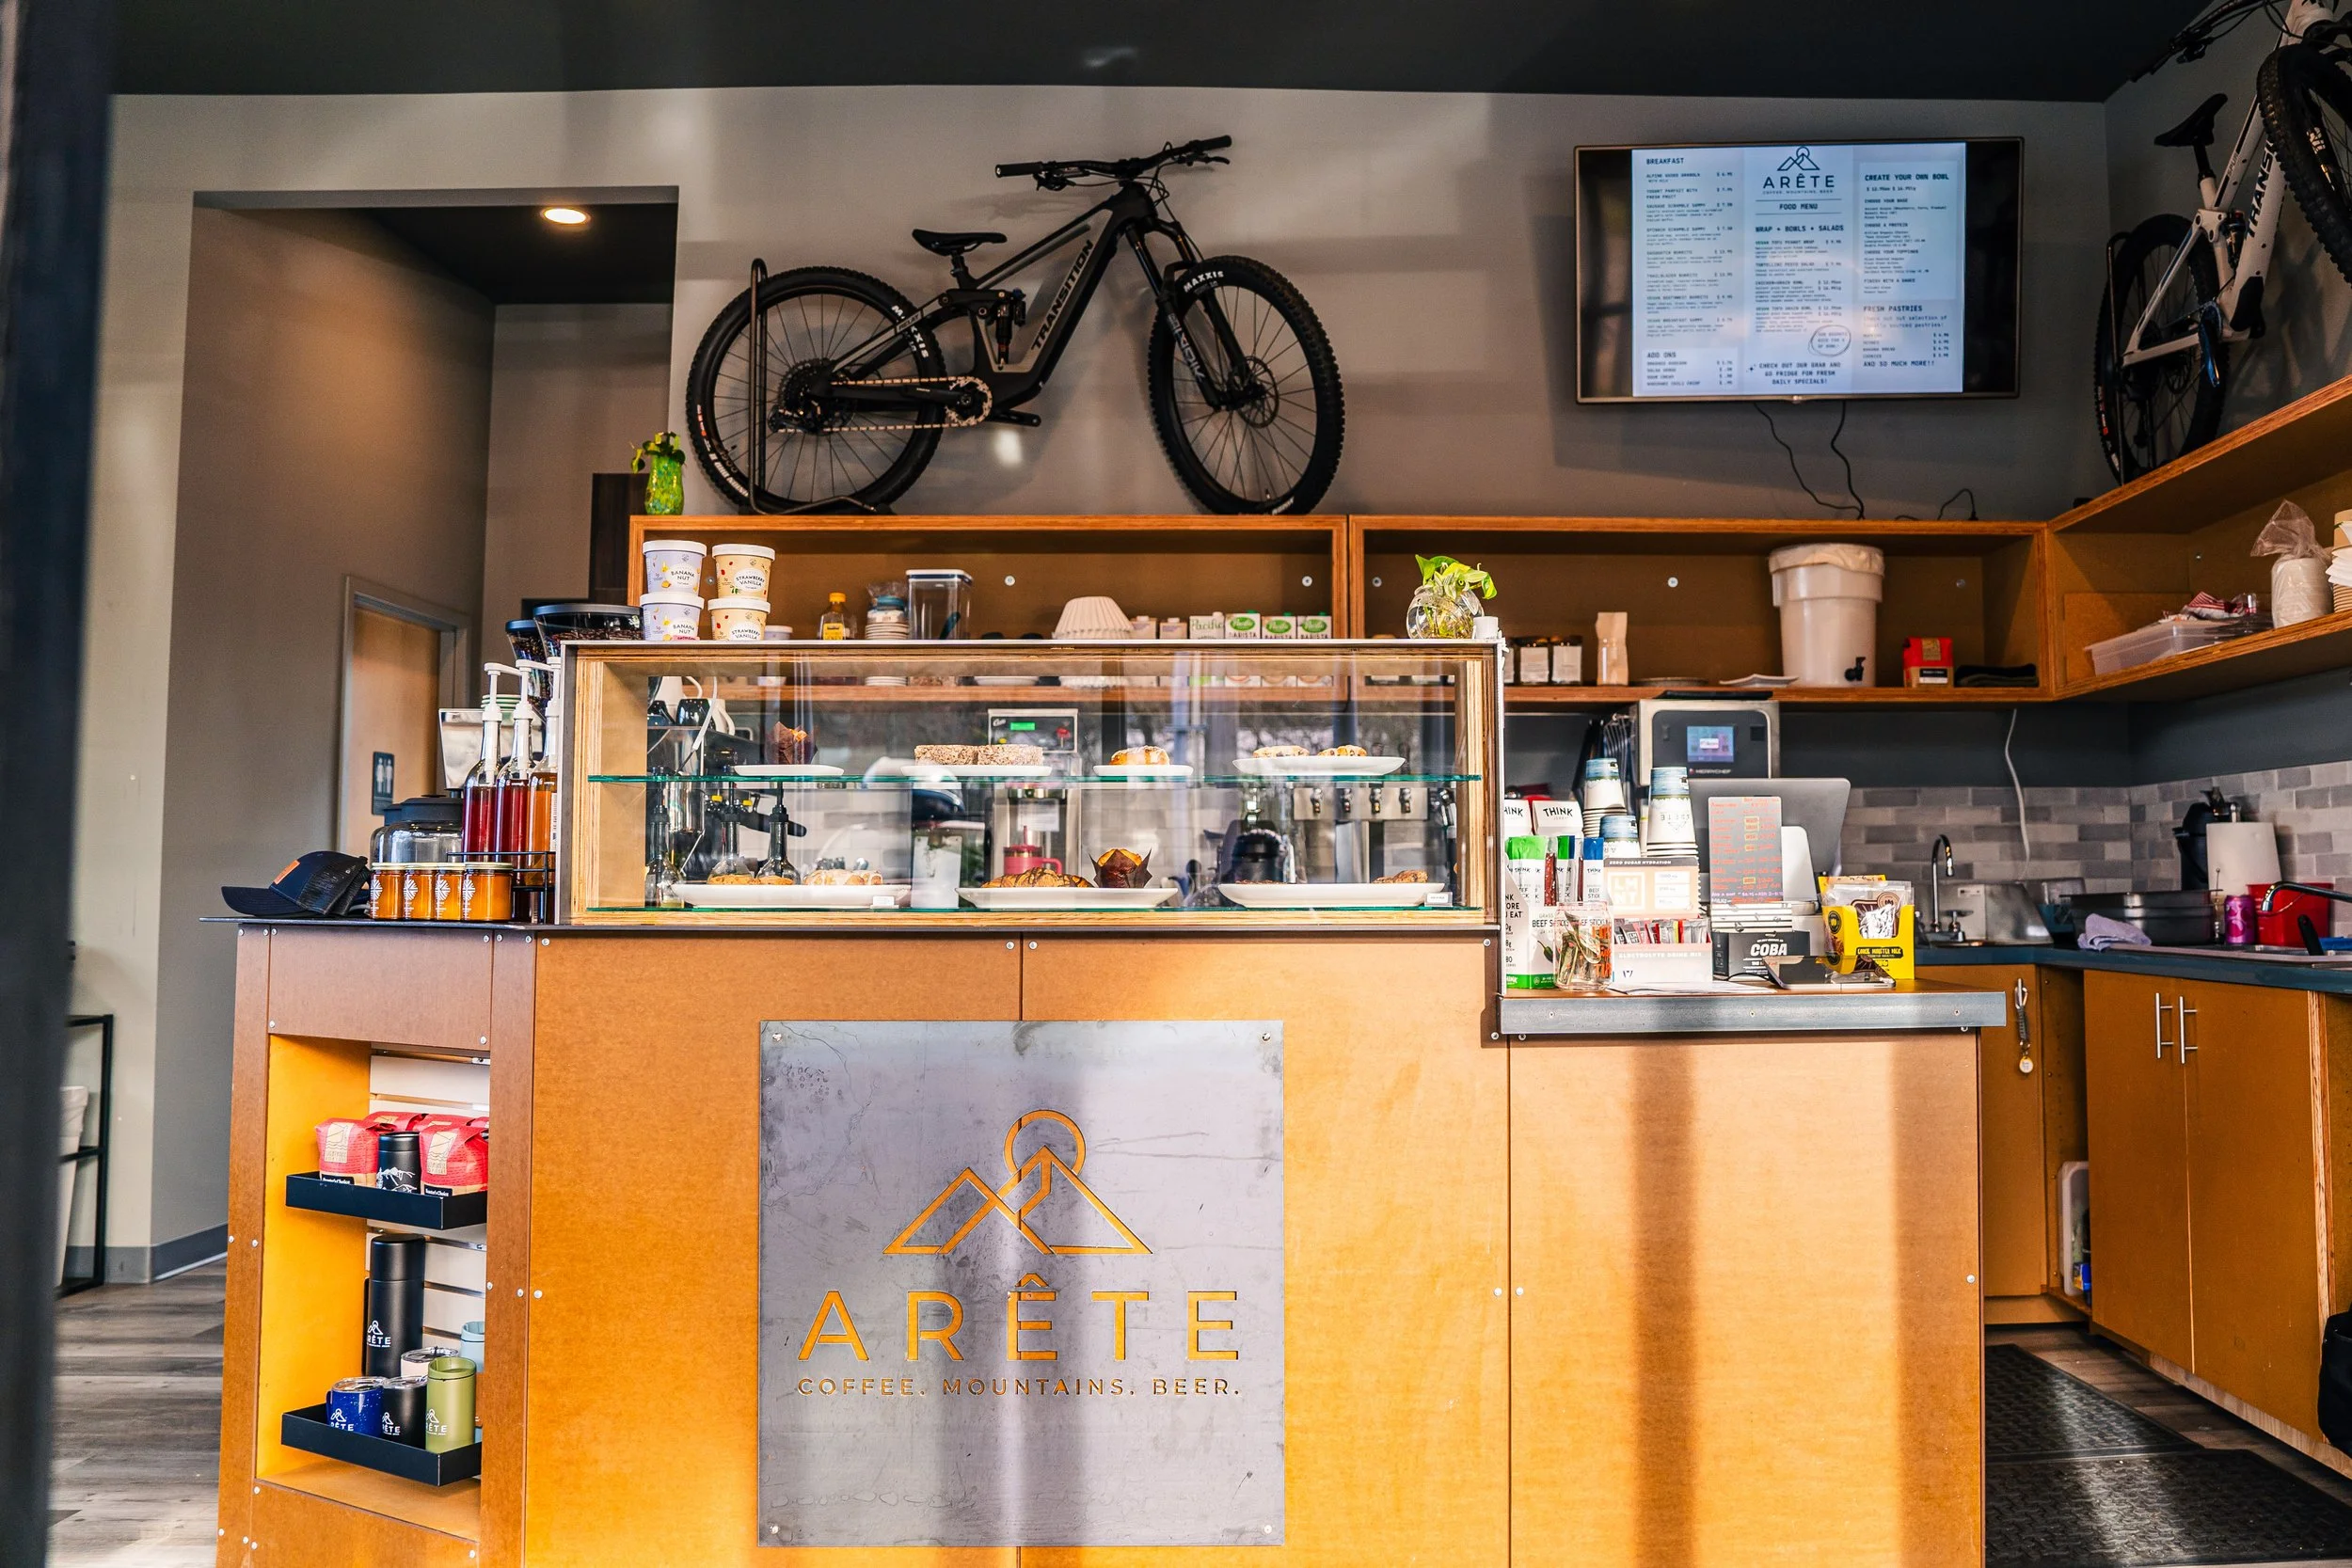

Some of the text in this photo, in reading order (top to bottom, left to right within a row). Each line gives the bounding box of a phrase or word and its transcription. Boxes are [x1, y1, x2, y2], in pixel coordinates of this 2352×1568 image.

[1763, 173, 1835, 188] ARÊTE
[2248, 138, 2278, 238] TRANSI
[1184, 270, 1225, 293] MAXXIS
[1031, 239, 1093, 350] TRANSITION
[891, 305, 930, 358] MXXIS
[1191, 617, 1223, 630] Pacific
[1504, 806, 1523, 816] HINK
[1543, 807, 1573, 817] THINK
[1750, 942, 1788, 957] COBA
[797, 1273, 1239, 1362] ARÊTE
[367, 1334, 391, 1345] RÊTE
[797, 1377, 1240, 1396] COFFEE. MOUNTAINS. BEER.
[331, 1420, 355, 1432] RÊTE
[382, 1423, 401, 1433] RÊTE
[426, 1422, 448, 1433] RÊTE
